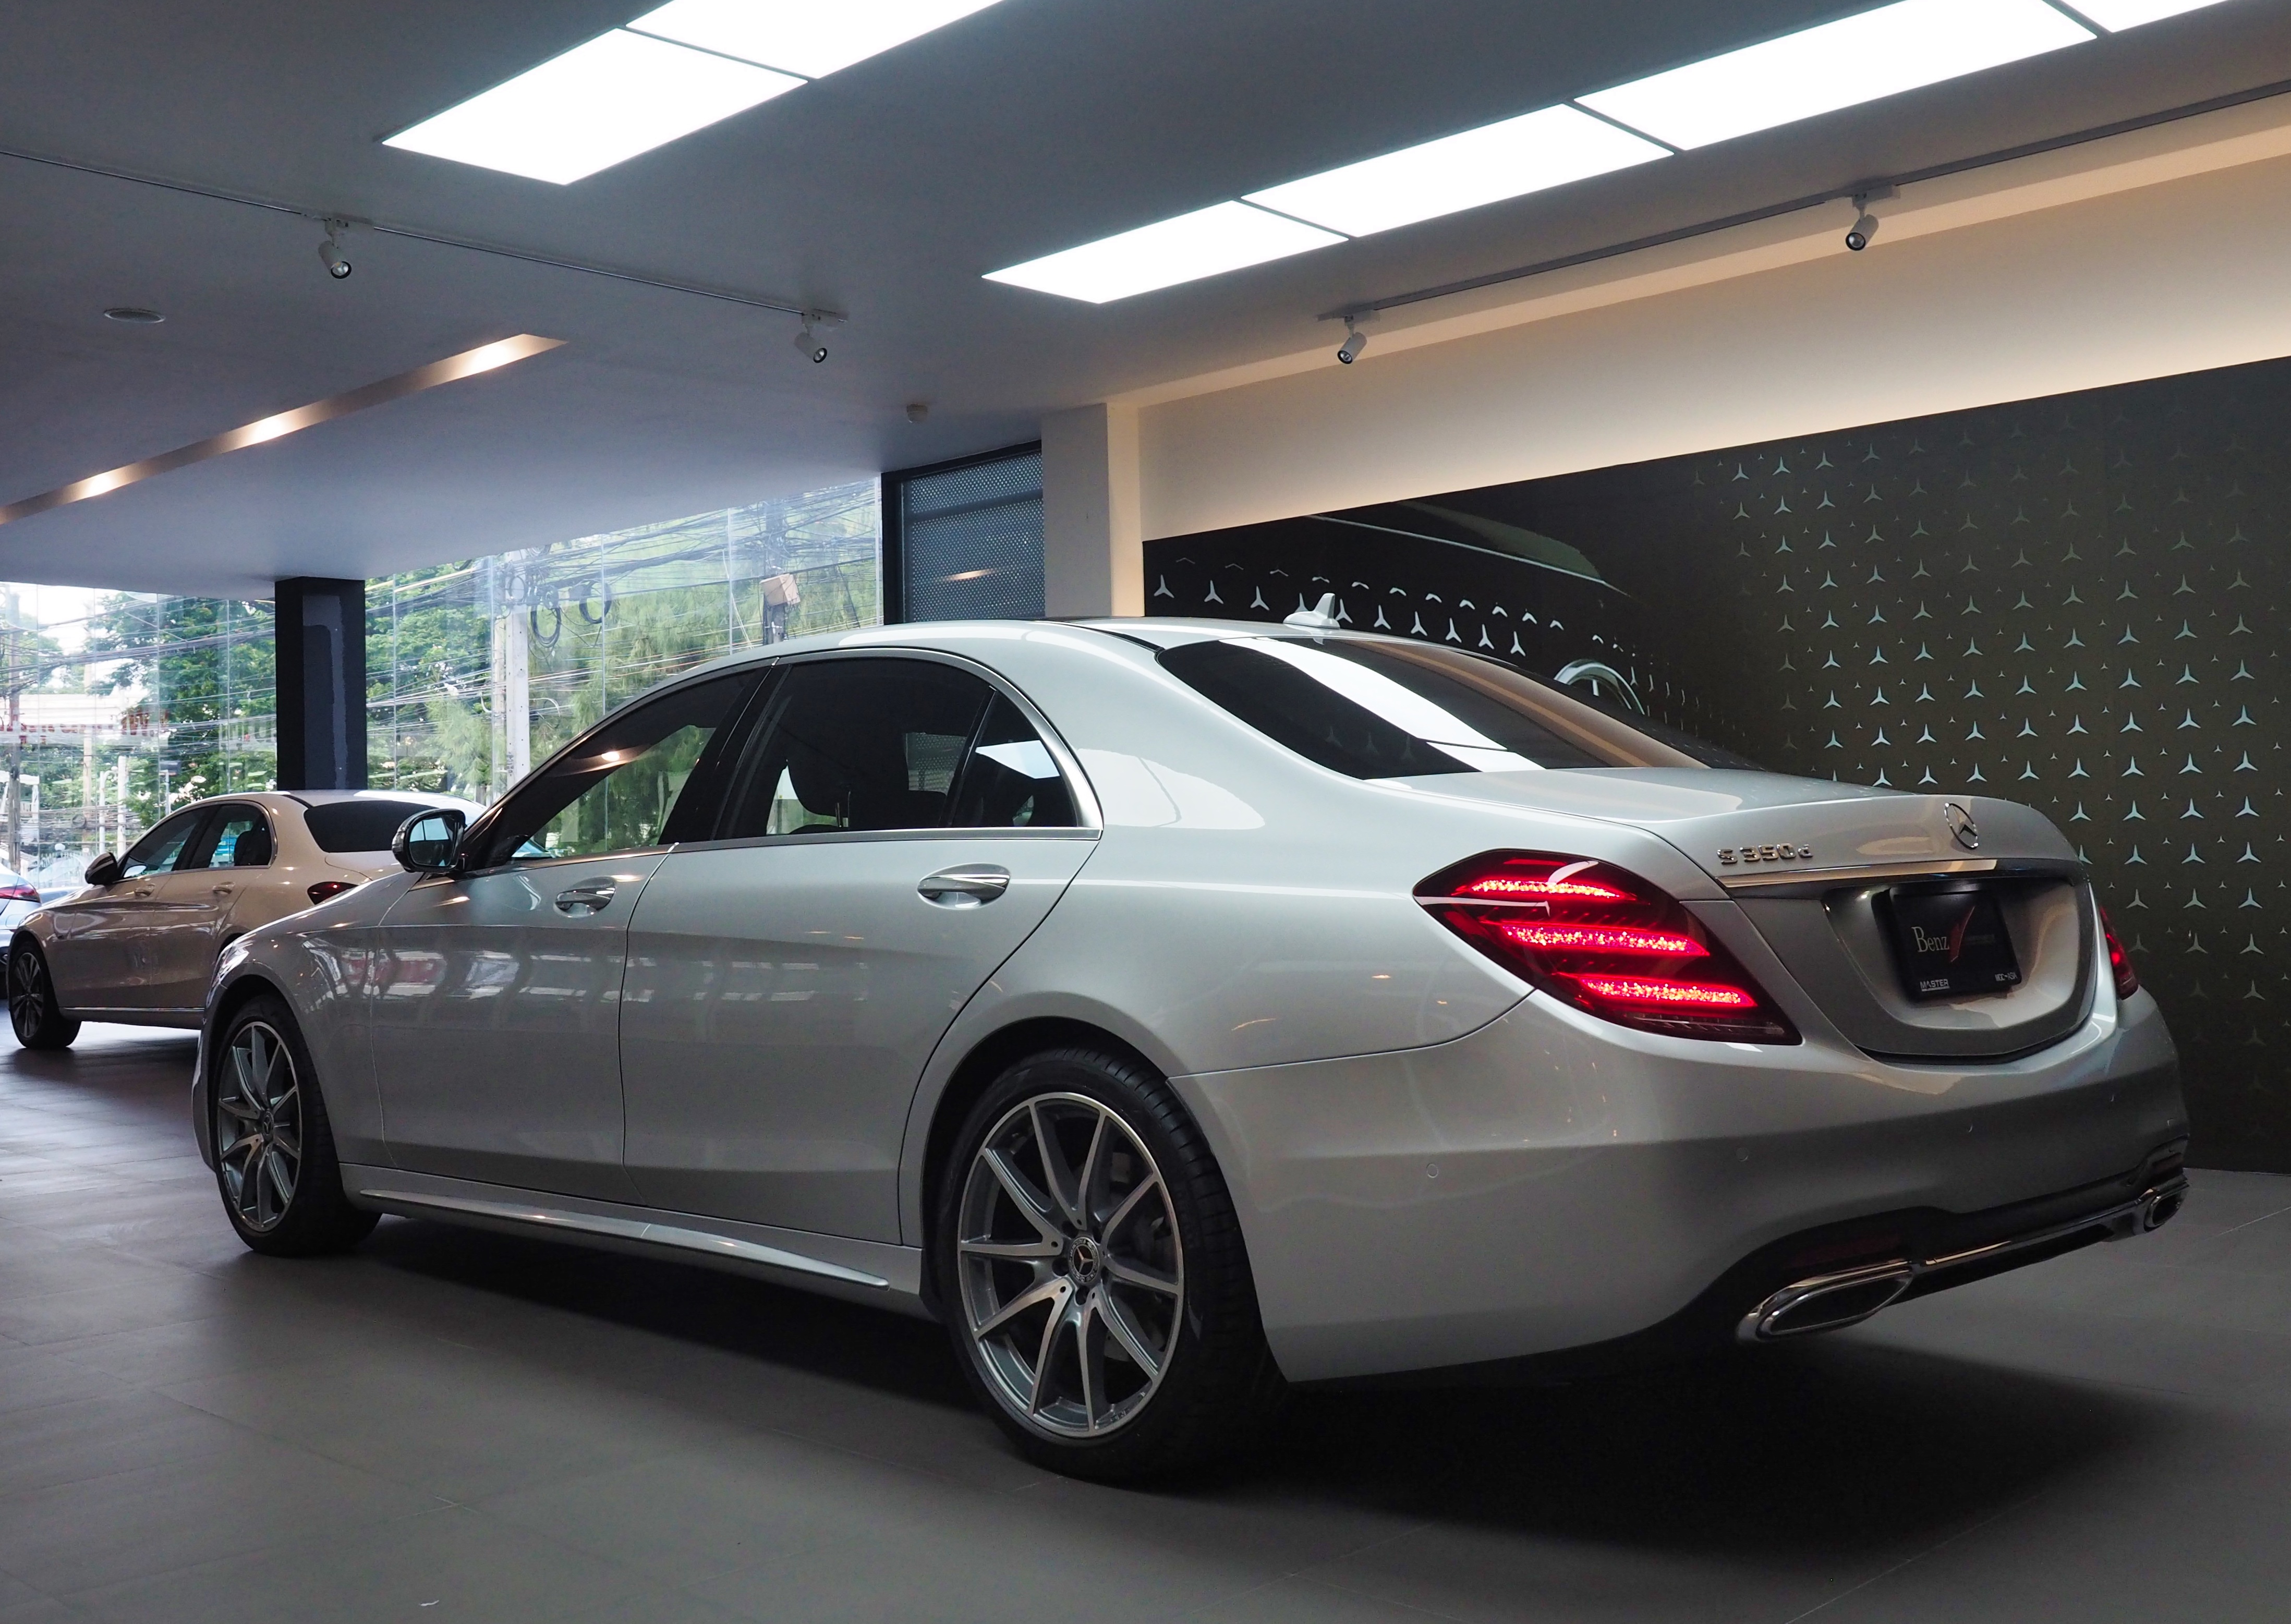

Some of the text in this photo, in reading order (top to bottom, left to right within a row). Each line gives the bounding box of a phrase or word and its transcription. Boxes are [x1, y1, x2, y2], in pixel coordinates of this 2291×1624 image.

[1717, 848, 1738, 865] S
[1911, 926, 1949, 952] Benz
[1920, 979, 1949, 989] MASTER
